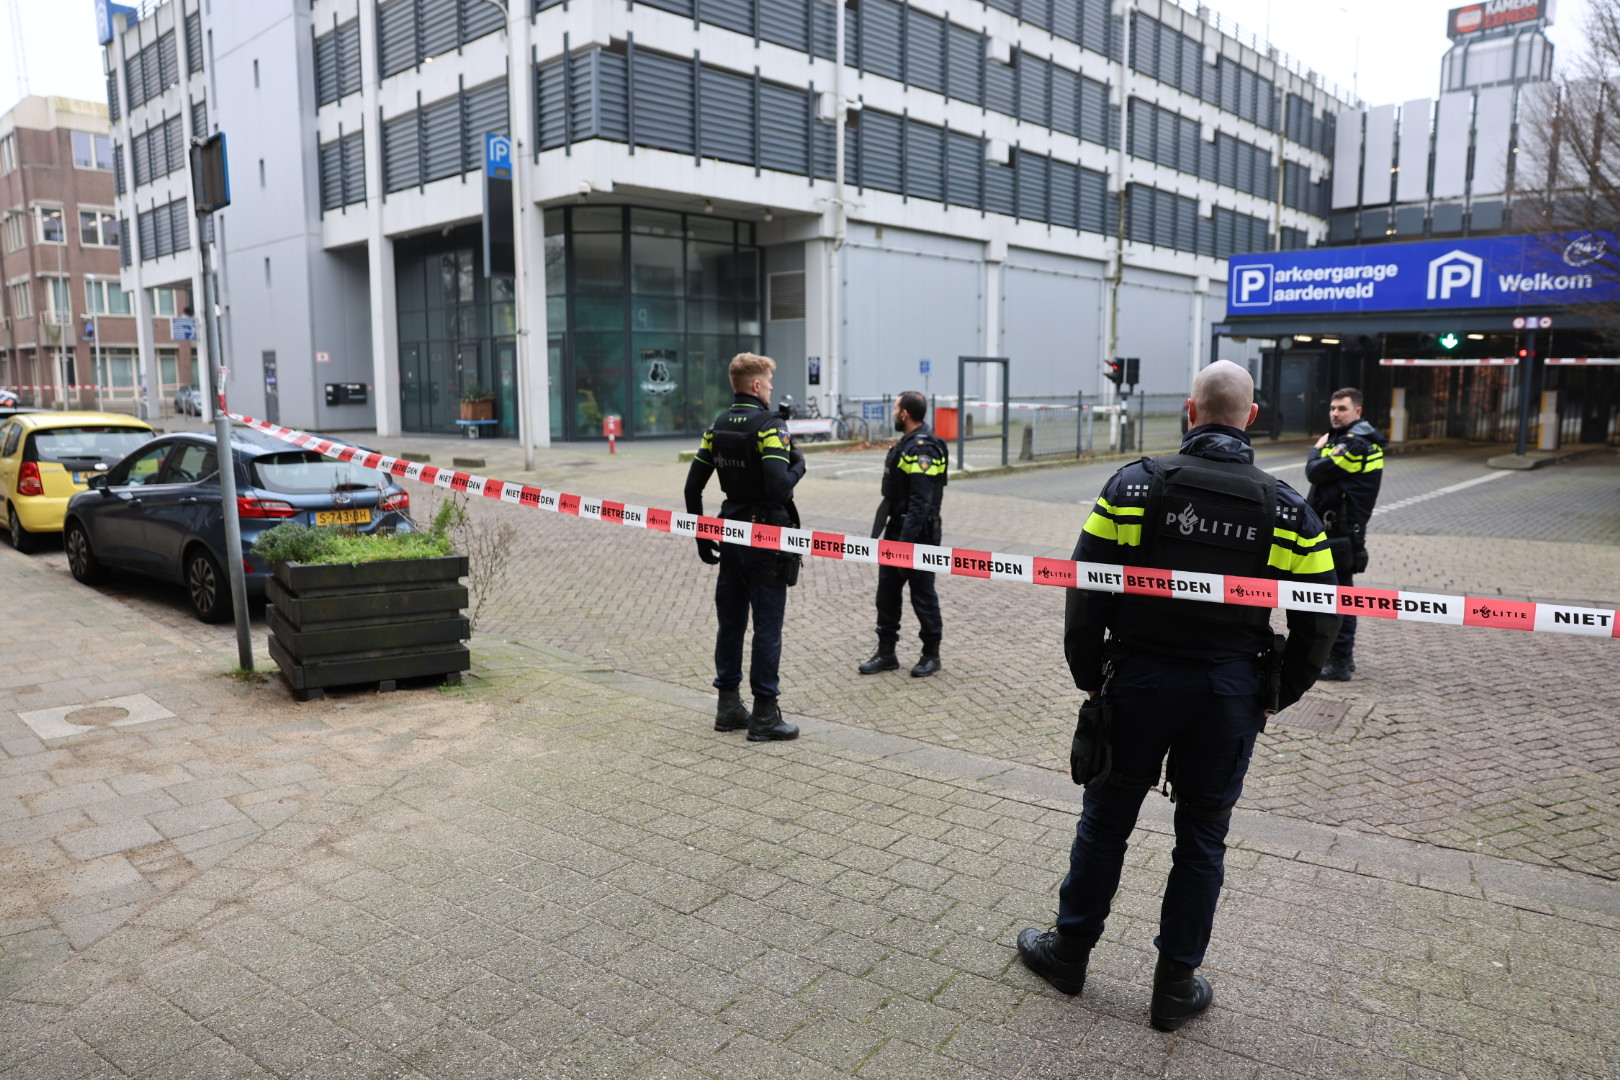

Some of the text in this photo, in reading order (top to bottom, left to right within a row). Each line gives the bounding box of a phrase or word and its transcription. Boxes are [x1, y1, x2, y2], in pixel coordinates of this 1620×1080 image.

[1274, 264, 1398, 284] arkeergarage
[1499, 273, 1592, 292] Welkom
[1273, 282, 1374, 301] aardenveld
[1166, 502, 1257, 541] POLITIE
[381, 460, 393, 468] NIET
[393, 463, 418, 475] BETREDEN
[439, 474, 451, 482] NIET
[452, 477, 480, 490] BETREDEN
[505, 488, 520, 499] NIET
[521, 492, 554, 506] BETREDEN
[584, 504, 600, 514] NIET
[602, 508, 641, 522] BETREDEN
[676, 519, 696, 531] NIET
[698, 523, 744, 539] BETREDEN
[754, 531, 778, 542] POLITIE
[787, 535, 810, 548] NIET
[813, 539, 869, 556] BETREDEN
[881, 548, 910, 560] POLITIE
[922, 552, 950, 566] NIET
[954, 557, 1022, 575] BETREDEN
[1037, 565, 1072, 579] POLITIE
[1087, 571, 1122, 586] NIET
[1127, 575, 1211, 594] BETREDEN
[1230, 584, 1273, 598] POLITIE
[1292, 590, 1335, 605] NIET
[1341, 594, 1447, 614] BETREDEN
[1472, 605, 1527, 619] POLITIE
[1554, 611, 1611, 627] NIET
